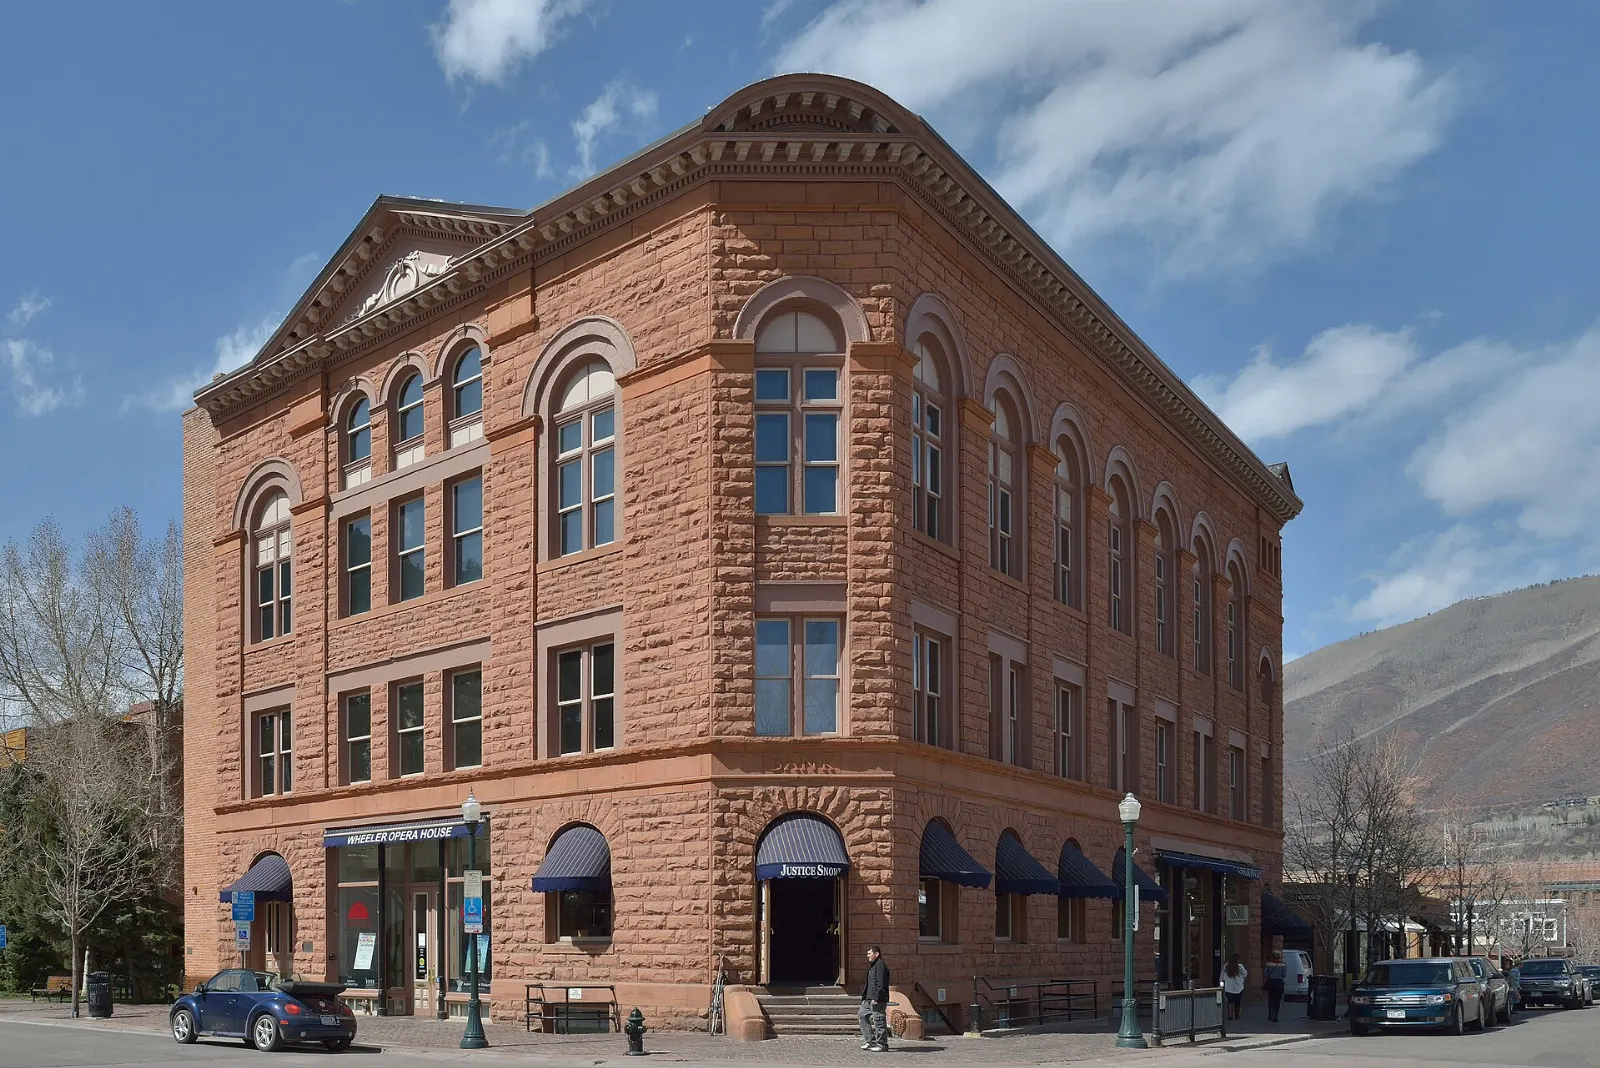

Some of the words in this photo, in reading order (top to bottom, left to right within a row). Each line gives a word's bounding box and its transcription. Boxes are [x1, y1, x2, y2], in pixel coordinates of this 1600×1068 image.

[771, 756, 840, 774] BANK
[347, 831, 387, 845] WHEELER
[388, 829, 418, 841] OPERA
[419, 826, 453, 839] HOUSE
